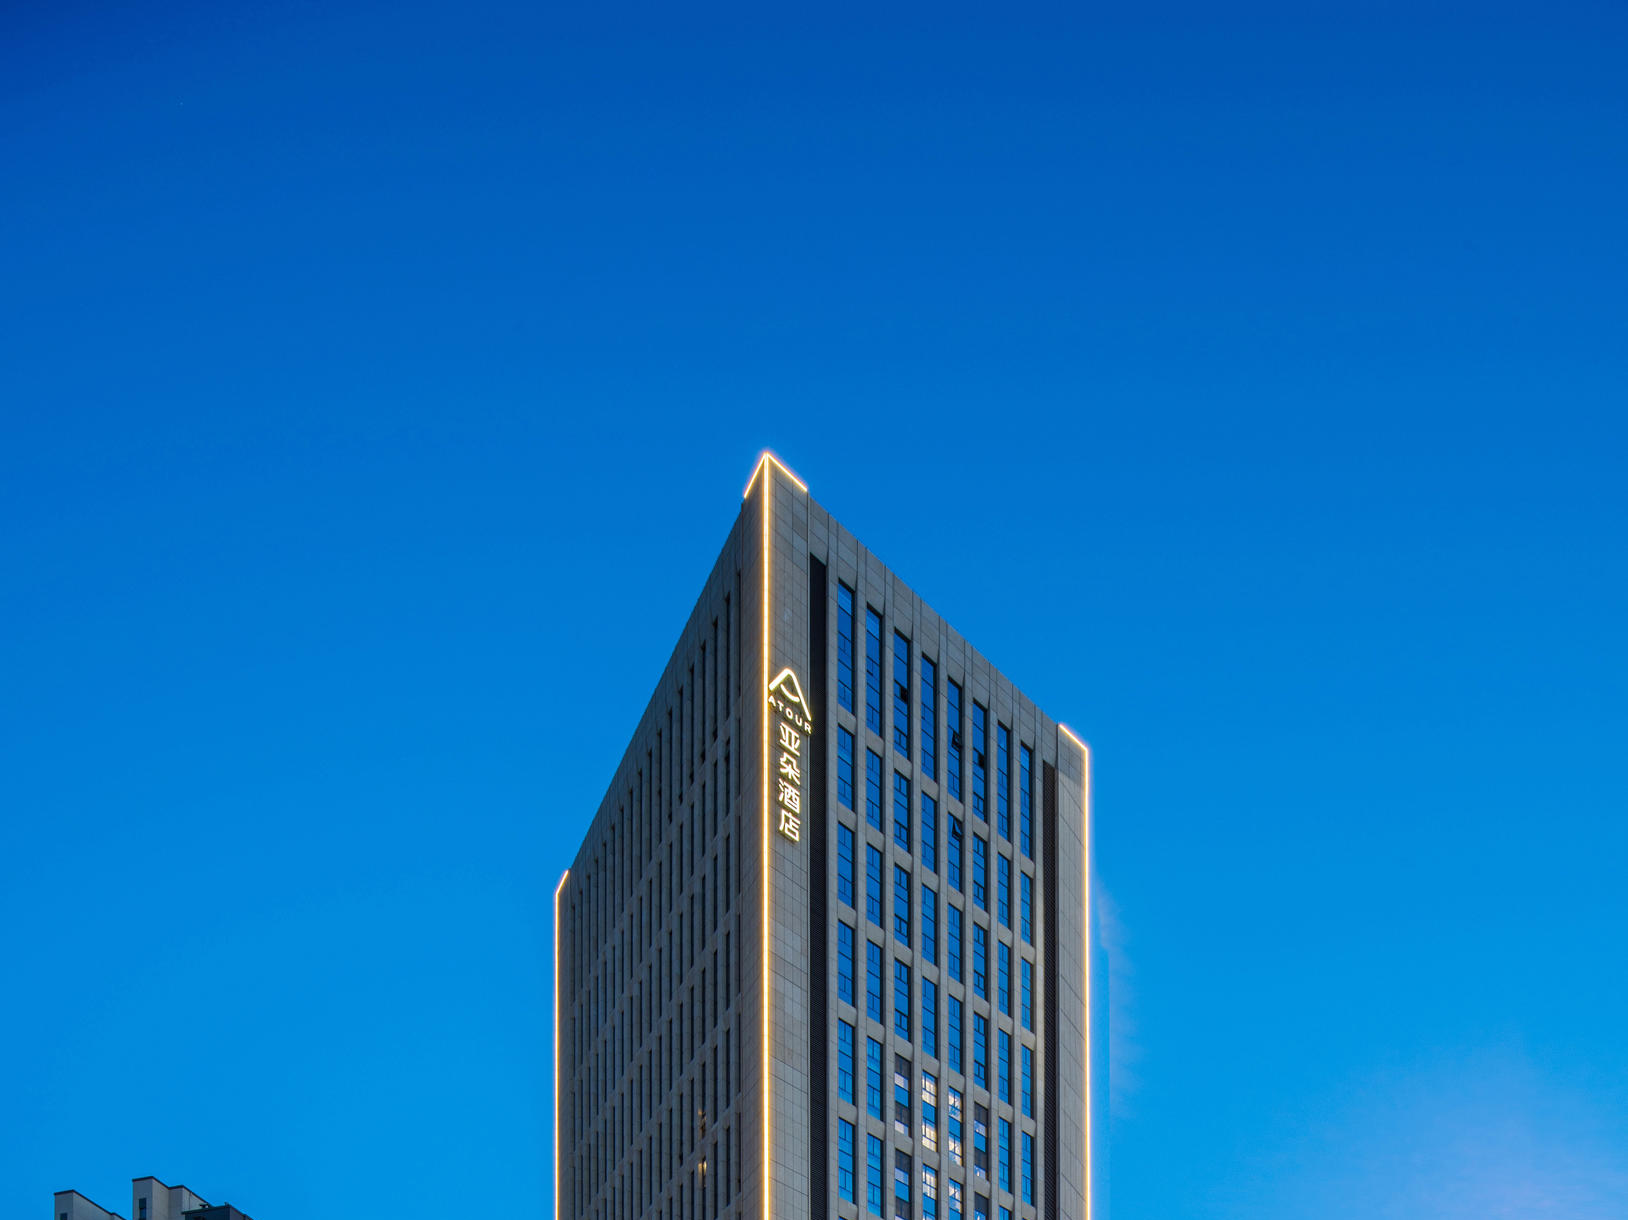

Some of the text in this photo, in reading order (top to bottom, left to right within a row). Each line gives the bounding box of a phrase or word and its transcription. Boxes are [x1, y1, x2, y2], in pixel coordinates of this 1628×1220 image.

[768, 695, 811, 734] ATOUR
[779, 722, 801, 842] 亚朵酒店
